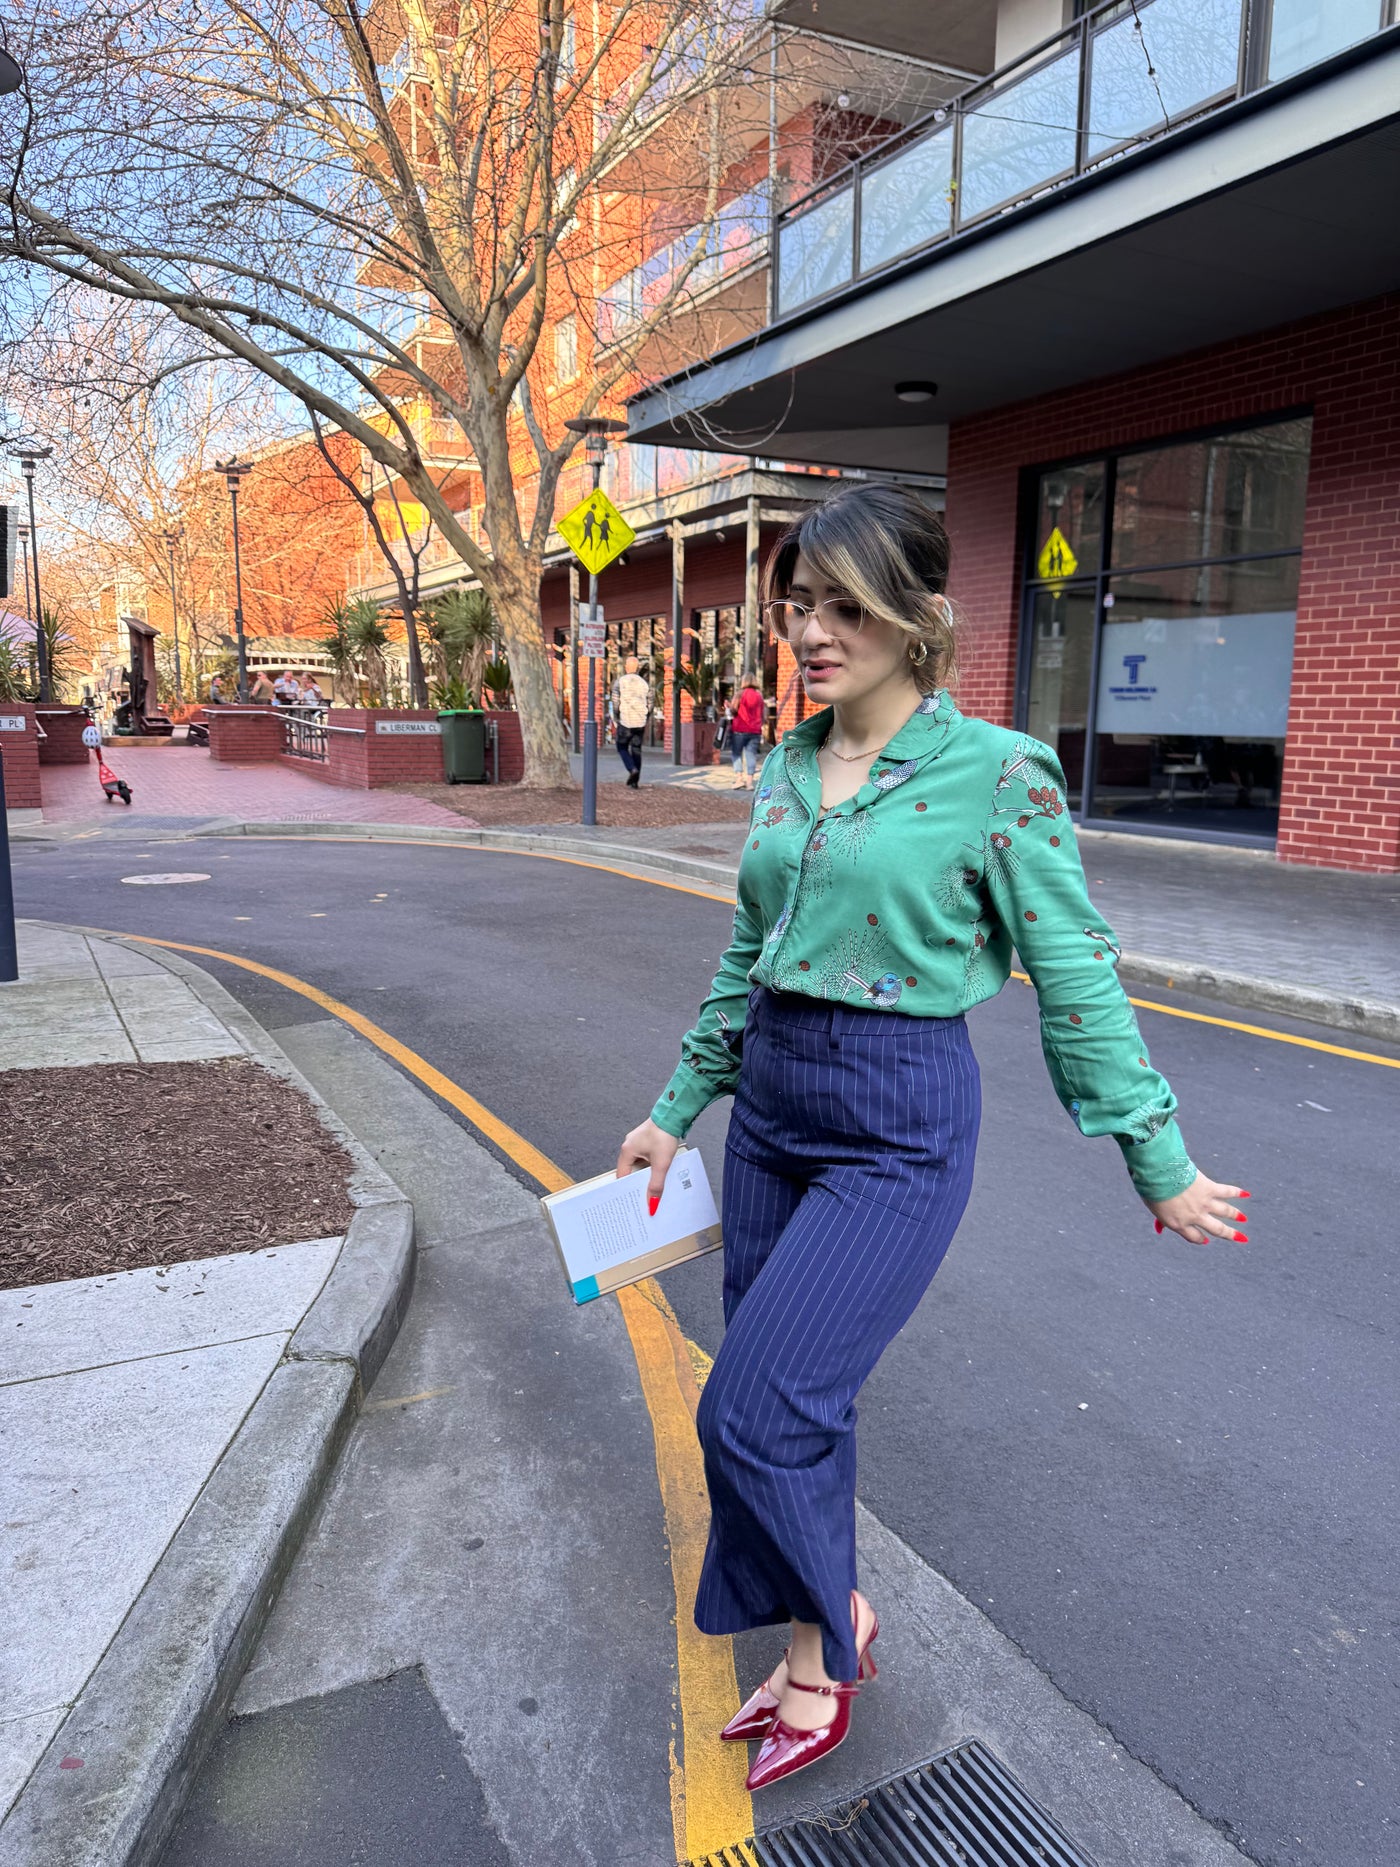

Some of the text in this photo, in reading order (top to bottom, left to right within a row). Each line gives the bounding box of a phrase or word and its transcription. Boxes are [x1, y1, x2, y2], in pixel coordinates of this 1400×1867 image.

[1123, 655, 1146, 684] T
[9, 720, 20, 728] PL
[390, 724, 426, 732] LIBERMAN
